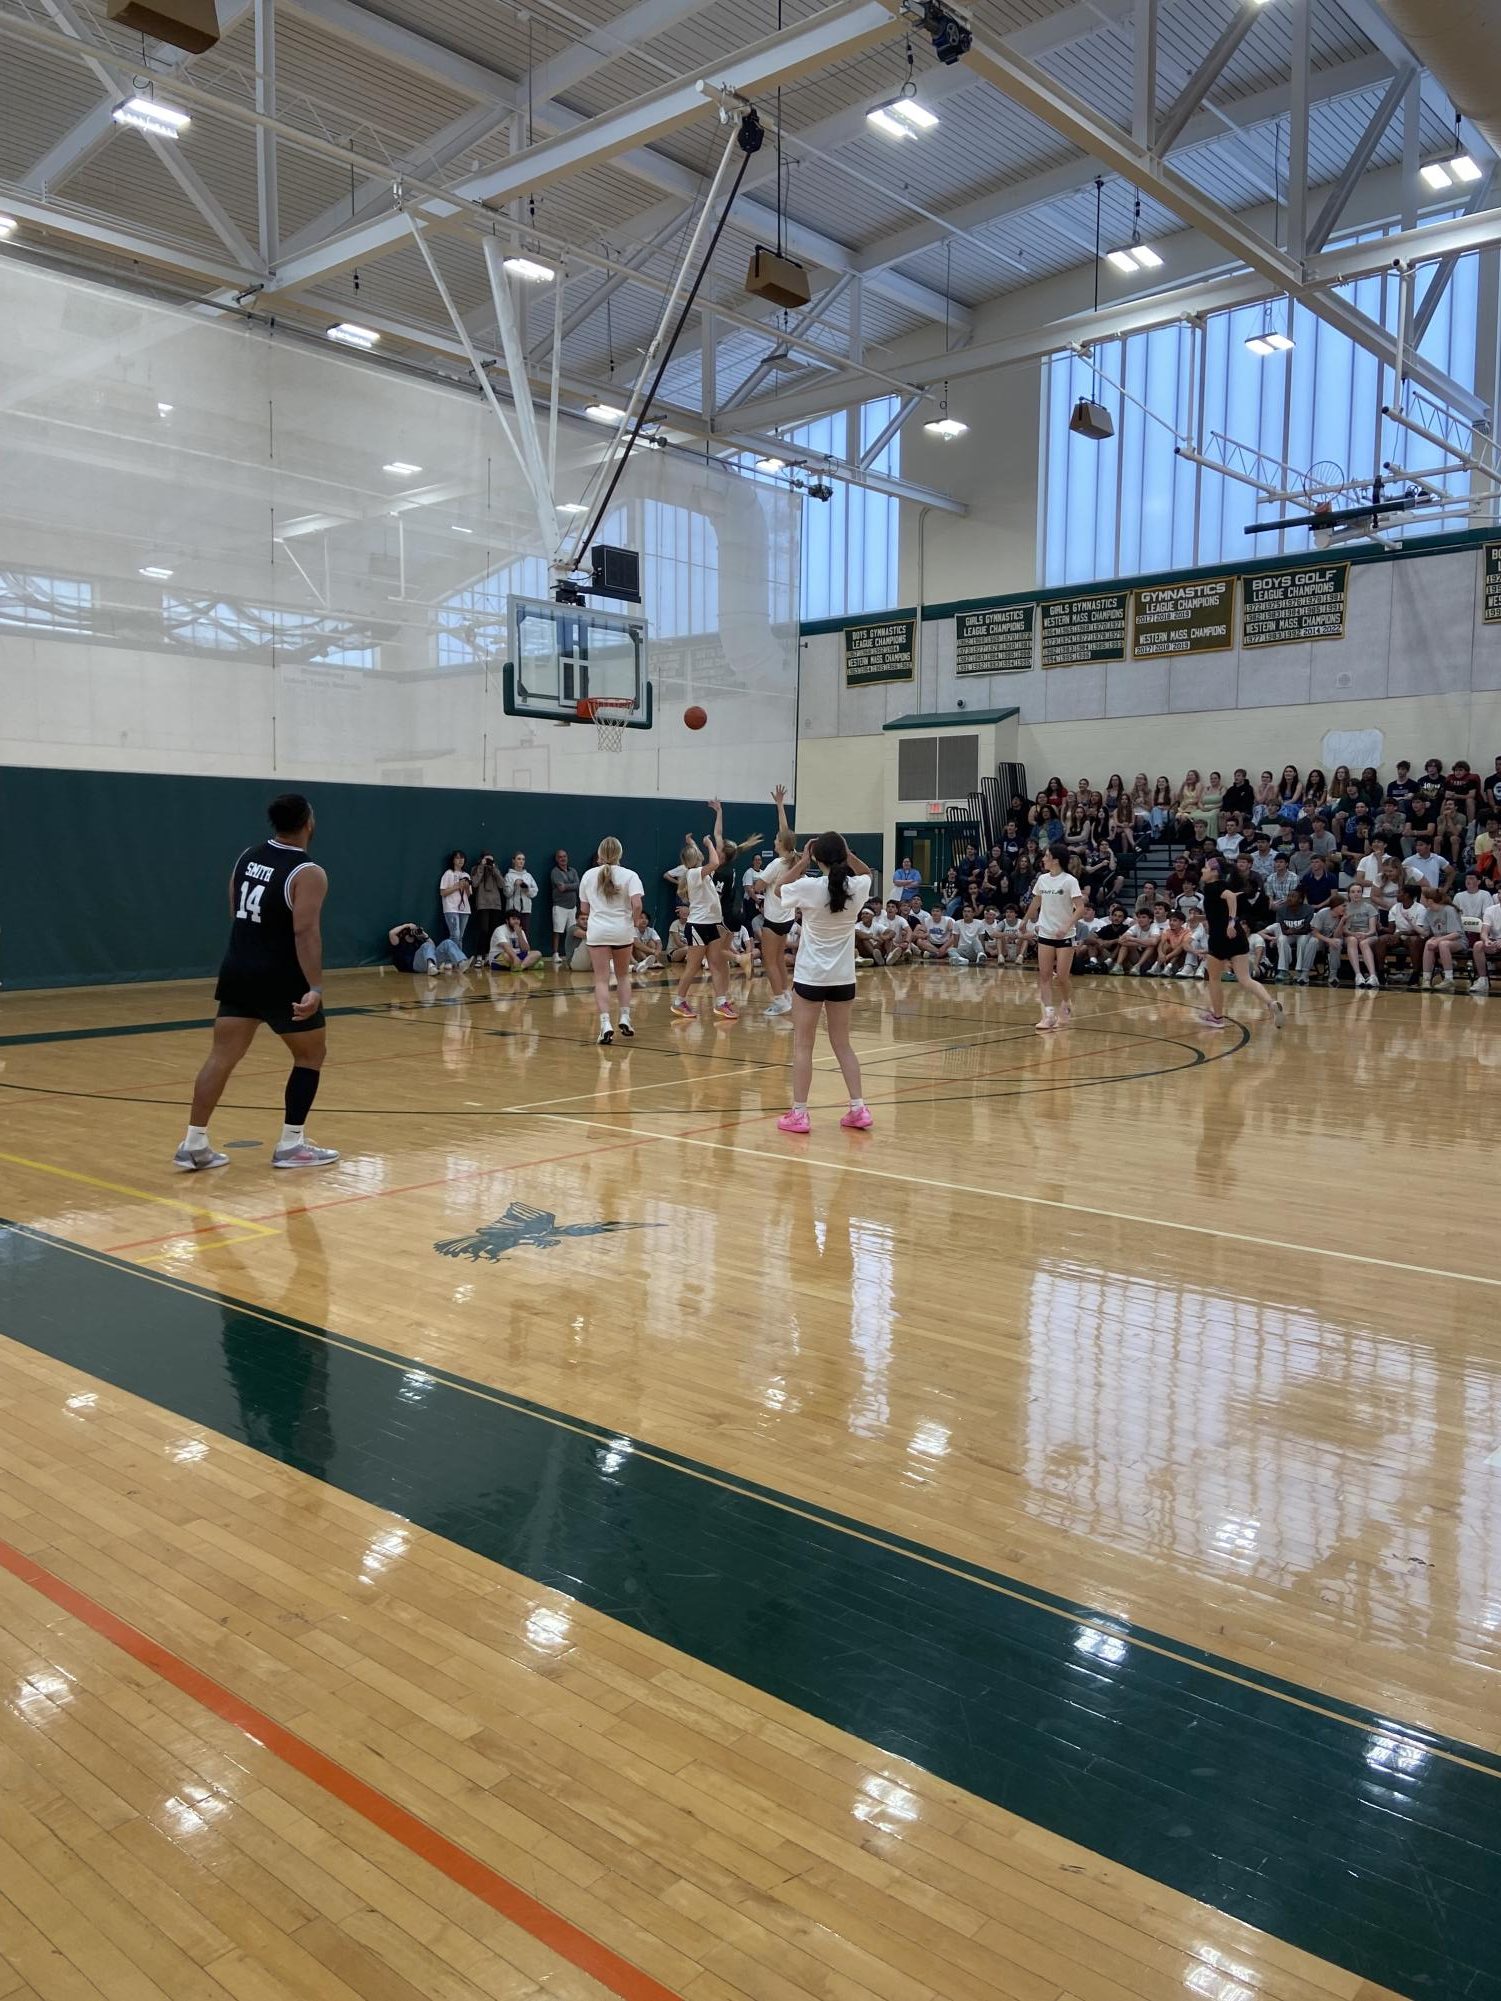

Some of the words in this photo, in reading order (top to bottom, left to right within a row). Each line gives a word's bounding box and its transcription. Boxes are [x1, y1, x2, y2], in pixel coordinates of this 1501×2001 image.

[1253, 576, 1291, 590] BOYS
[1295, 570, 1337, 584] GOLF
[1141, 582, 1226, 602] GYMNASTICS
[1254, 588, 1284, 601] LEAGUE
[1288, 582, 1334, 597] CHAMPIONS
[1050, 605, 1069, 615] GIRLS
[1073, 598, 1117, 612] GYMNASTICS
[1146, 601, 1174, 613] LEAGUE
[1178, 595, 1219, 610] CHAMPIONS
[1283, 598, 1301, 608] 1976
[966, 616, 983, 626] GIRLS
[986, 611, 1023, 623] GYMNASTICS
[1044, 615, 1069, 627] WESTERN
[1091, 609, 1123, 621] CHAMPIONS
[1136, 615, 1153, 624] 2017
[1246, 621, 1275, 633] WESTERN
[1302, 614, 1341, 626] CHAMPIONS
[870, 625, 906, 637] GYMNASTICS
[964, 626, 987, 636] LEAGUE
[990, 621, 1024, 634] CHAMPIONS
[1140, 632, 1168, 644] WESTERN
[1191, 625, 1226, 638] CHAMPIONS
[1283, 630, 1301, 639] 1992
[1302, 627, 1320, 636] 2014
[1322, 625, 1341, 633] 2022
[852, 639, 873, 649] LEAGUE
[875, 635, 906, 646] CHAMPIONS
[1135, 646, 1152, 655] 2017
[849, 657, 868, 667] WESTERN
[885, 652, 910, 662] CHAMPIONS
[245, 861, 275, 882] SMITH
[236, 881, 265, 923] 14
